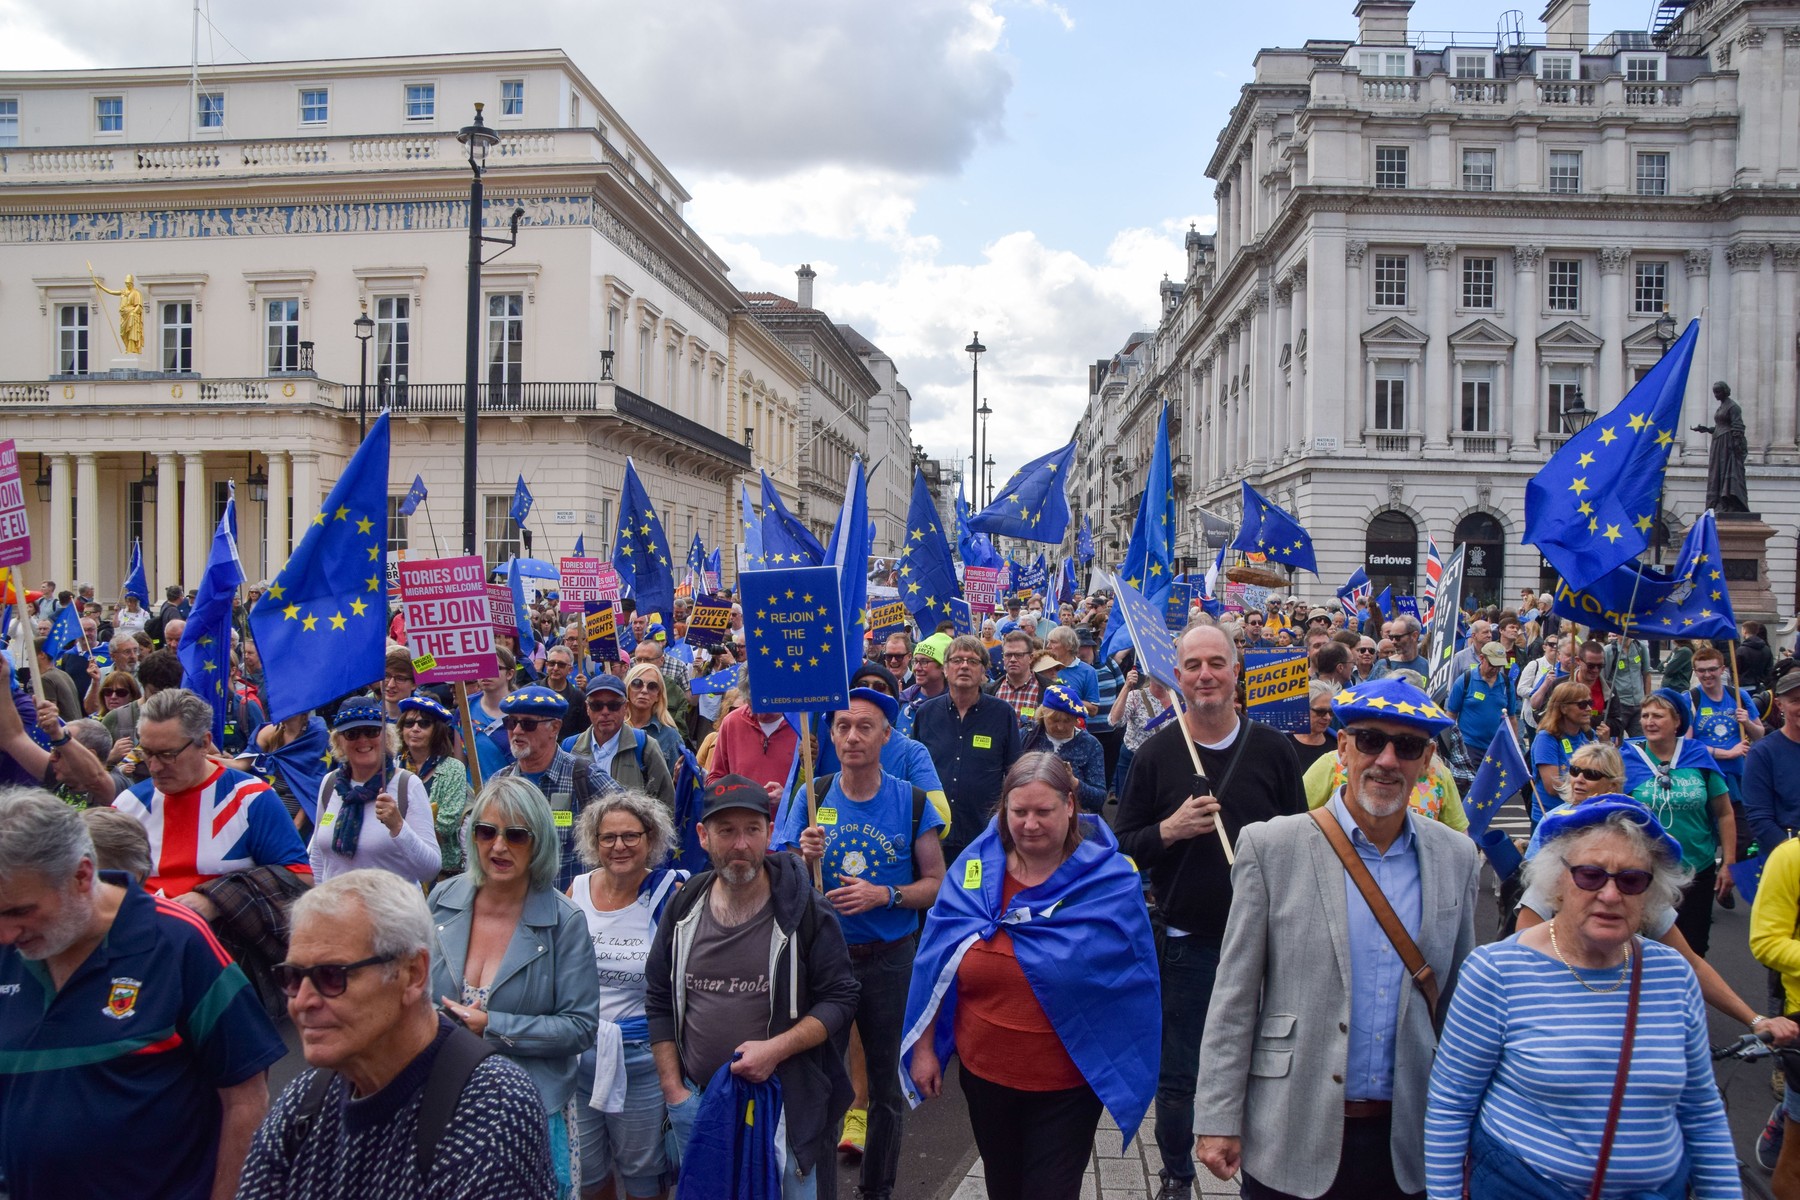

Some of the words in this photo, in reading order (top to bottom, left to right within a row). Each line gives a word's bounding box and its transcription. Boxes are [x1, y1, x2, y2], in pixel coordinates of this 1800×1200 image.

[1, 449, 16, 466] OUT
[9, 511, 26, 538] EU
[1368, 554, 1412, 564] farlows
[402, 568, 452, 586] TORIES
[454, 566, 480, 581] OUT
[562, 576, 597, 587] REJOIN
[405, 585, 444, 596] MIGRANTS
[444, 582, 483, 594] WELCOME
[966, 582, 995, 592] REJOIN
[562, 590, 582, 600] THE
[584, 590, 597, 600] EU
[966, 592, 982, 602] THE
[983, 594, 994, 604] EU
[408, 598, 486, 626] REJOIN
[490, 601, 514, 614] EJOIN
[694, 608, 730, 617] LOWER
[872, 604, 904, 618] CLEAN
[491, 613, 502, 624] HE
[503, 615, 514, 626] EU
[587, 612, 613, 628] WORKERS
[692, 616, 727, 627] BILLS
[770, 612, 814, 624] REJOIN
[872, 612, 904, 628] RIVERS
[588, 620, 614, 638] RIGHTS
[782, 628, 806, 640] THE
[412, 632, 456, 657] THE
[460, 630, 490, 654] EU
[786, 646, 804, 656] EU
[1248, 668, 1288, 686] PEACE
[1291, 662, 1306, 676] IN
[1248, 676, 1306, 700] EUROPE
[804, 696, 830, 704] EUROPE
[840, 824, 859, 834] FOR
[862, 824, 897, 864] EUROPE
[685, 972, 725, 992] Enter
